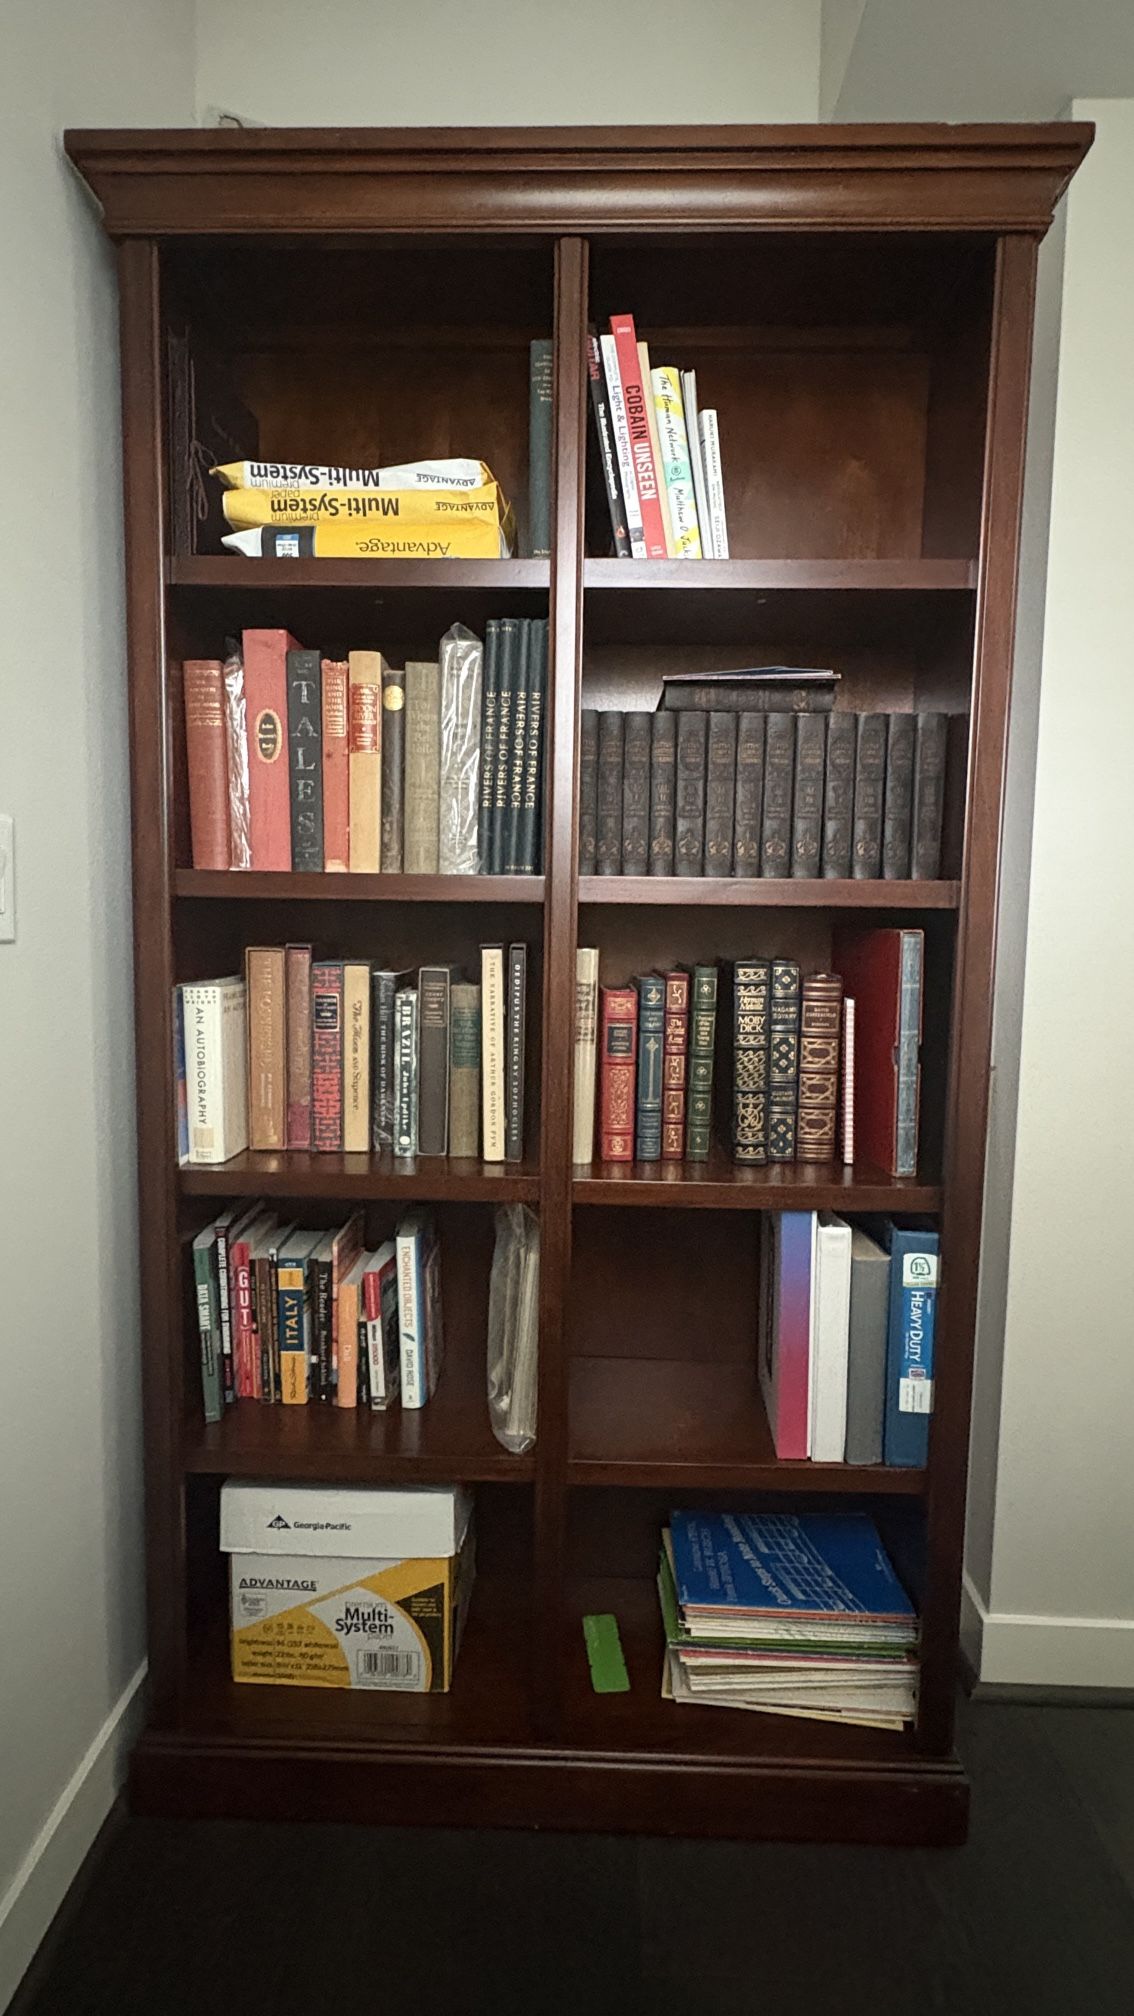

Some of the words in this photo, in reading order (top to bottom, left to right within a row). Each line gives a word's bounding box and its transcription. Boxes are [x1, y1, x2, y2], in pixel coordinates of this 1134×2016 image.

[659, 375, 673, 391] The
[625, 385, 648, 440] COBAIN
[662, 393, 674, 425] Human
[612, 385, 621, 411] Light
[618, 426, 631, 468] Lighting
[665, 427, 680, 463] Network
[250, 464, 380, 487] Multi-System
[416, 473, 476, 486] ADVANTAGE
[633, 442, 657, 500] UNSEEN
[271, 493, 400, 517] Multi-System
[271, 511, 320, 522] premium
[435, 501, 495, 512] ADVANTAGE
[486, 691, 497, 739] FRANCE
[500, 691, 512, 739] FRANCE
[515, 692, 526, 735] RIVERS
[529, 692, 541, 736] RIVERS
[292, 680, 319, 835] TALES
[498, 743, 509, 760] OF
[514, 736, 524, 757] OF
[528, 738, 539, 757] OF
[482, 764, 494, 808] RIVERS
[496, 764, 508, 808] RIVERS
[511, 758, 523, 809] FRANCE
[525, 758, 537, 809] FRANCE
[195, 1007, 205, 1024] AN
[352, 1000, 362, 1022] The
[738, 1016, 766, 1025] MOBY
[401, 1005, 411, 1064] BRAZIL
[740, 1024, 763, 1032] DICK
[196, 1029, 208, 1125] AUTOBIOGRAPHY
[380, 1066, 386, 1078] OF
[402, 1070, 410, 1095] John
[319, 1272, 328, 1290] The
[401, 1246, 412, 1292] ENCHANTED
[197, 1284, 209, 1303] DATA
[319, 1291, 328, 1322] Reader
[198, 1305, 211, 1331] SMART
[286, 1296, 298, 1344] ITALY
[403, 1293, 413, 1328] OBJECTS
[909, 1291, 924, 1331] HEAVY
[405, 1349, 414, 1368] DAVID
[908, 1331, 923, 1361] DUTY
[406, 1369, 414, 1386] ROSE
[239, 1578, 317, 1591] ADVANTAGE
[335, 1618, 394, 1635] System
[345, 1608, 395, 1622] Multi-
